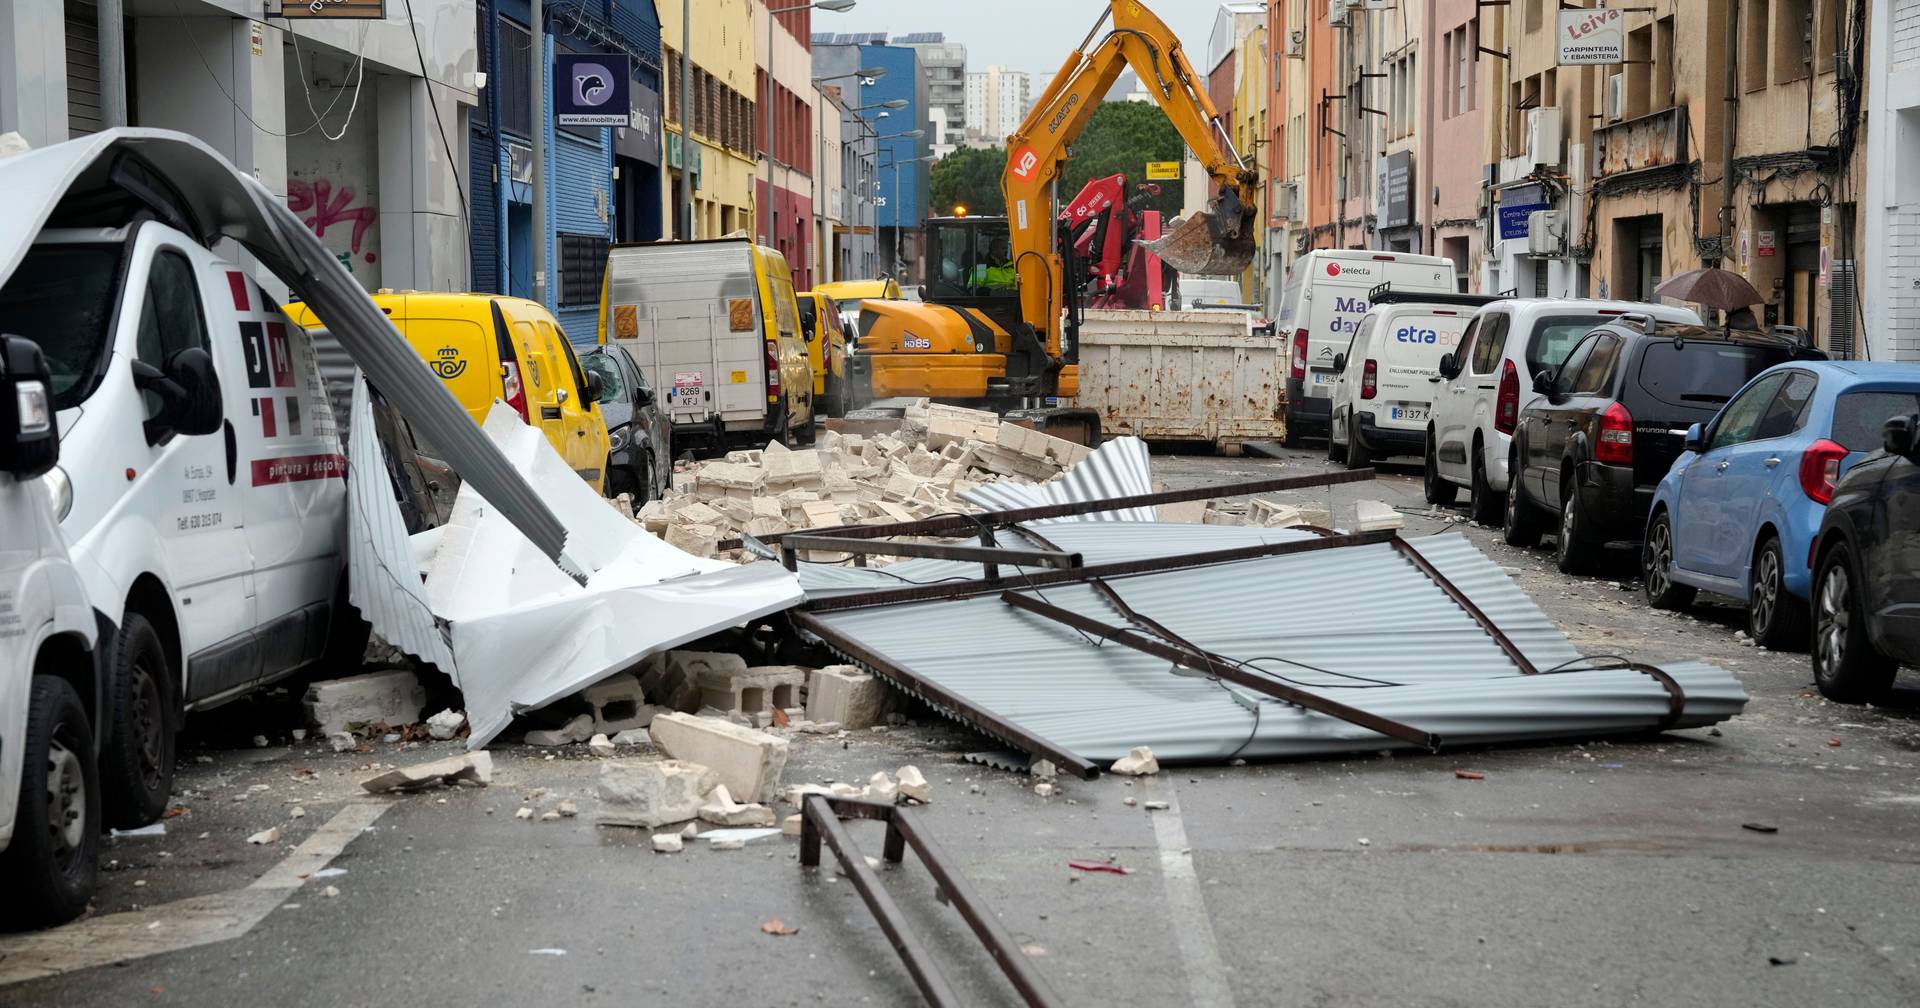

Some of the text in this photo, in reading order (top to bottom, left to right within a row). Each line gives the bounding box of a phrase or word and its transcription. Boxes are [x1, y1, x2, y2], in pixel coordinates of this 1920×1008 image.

[1568, 9, 1619, 40] Leiva
[1048, 93, 1079, 134] KATO
[1014, 151, 1037, 177] va
[1341, 266, 1370, 275] selecta
[1397, 326, 1436, 344] etra
[680, 387, 700, 396] 8269
[682, 397, 698, 405] KFJ
[1397, 407, 1420, 418] 9137
[269, 463, 302, 479] pintura
[304, 463, 310, 476] y
